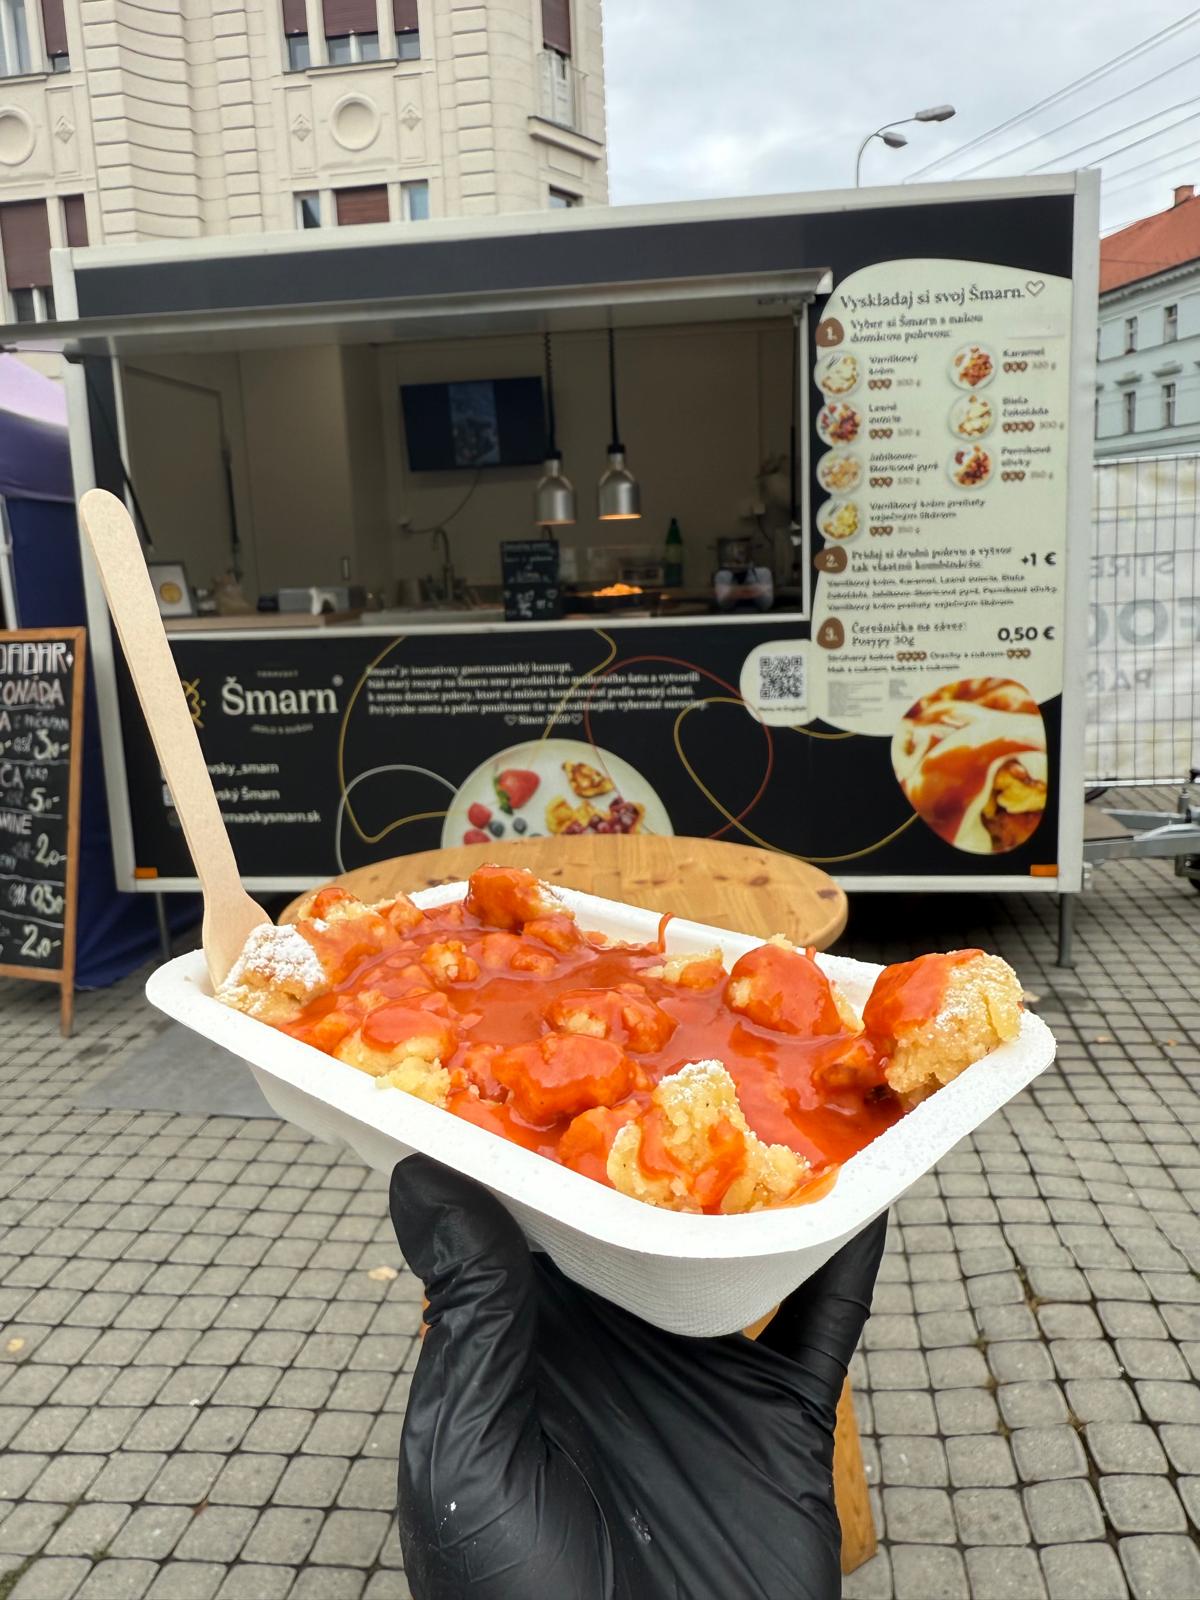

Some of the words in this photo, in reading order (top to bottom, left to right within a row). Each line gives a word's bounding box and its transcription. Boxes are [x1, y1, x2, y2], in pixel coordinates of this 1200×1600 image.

[841, 291, 914, 313] Vyskladaj
[917, 290, 930, 305] si
[935, 287, 966, 306] svoj
[997, 626, 1039, 644] 0,50
[1043, 625, 1055, 640] €
